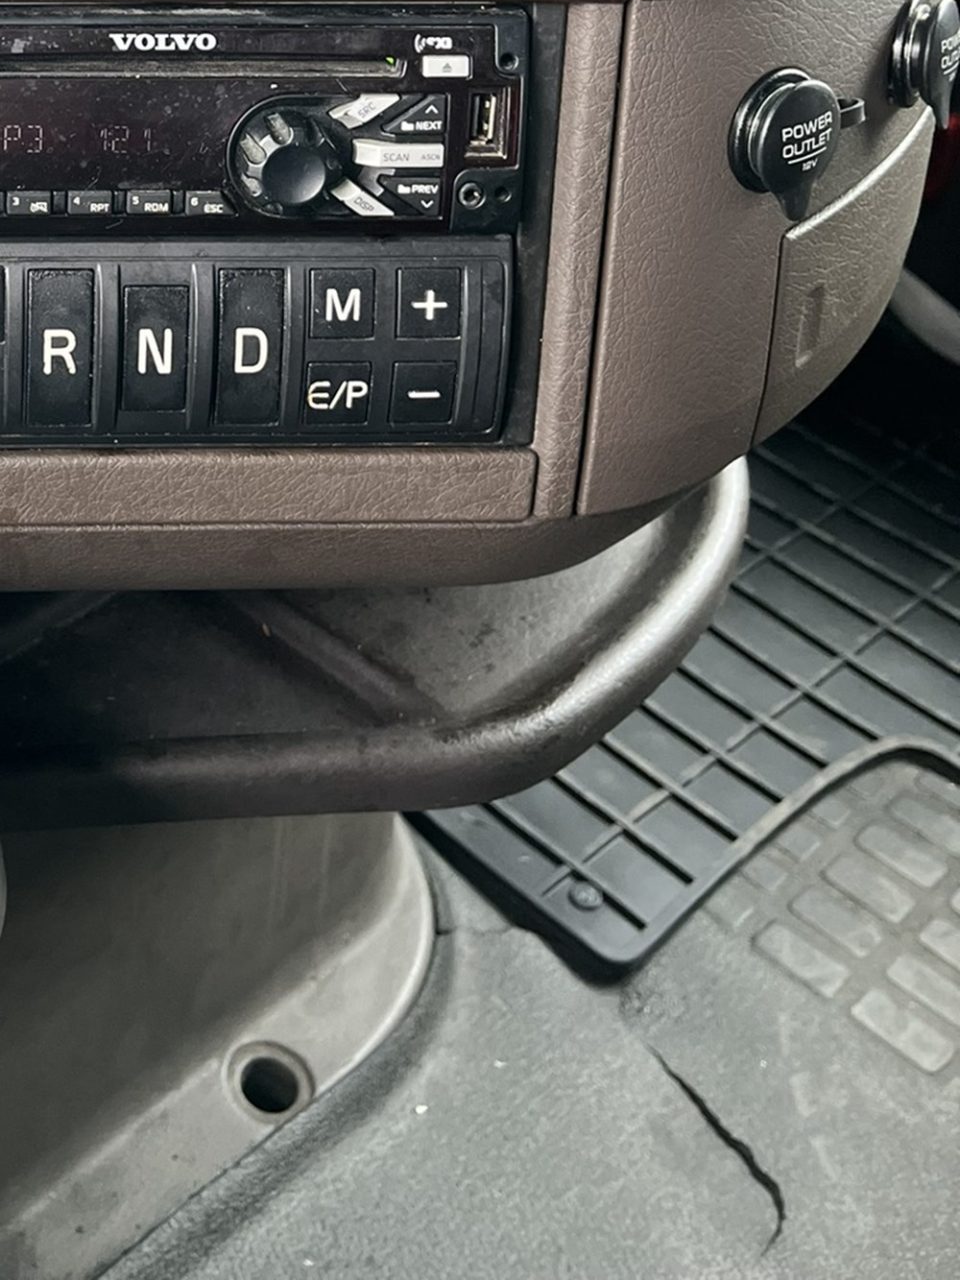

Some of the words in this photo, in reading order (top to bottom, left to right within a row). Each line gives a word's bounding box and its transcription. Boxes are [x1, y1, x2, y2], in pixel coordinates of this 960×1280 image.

[109, 33, 217, 51] VOLVO
[358, 101, 377, 119] SRC
[415, 121, 443, 131] NEXT
[781, 111, 833, 142] POWER
[4, 125, 43, 153] P3
[782, 128, 833, 159] OUTLET
[383, 152, 410, 162] SCAN
[411, 184, 439, 194] PREV
[12, 196, 20, 206] 3
[73, 196, 81, 205] 4
[90, 203, 110, 213] RPT
[132, 196, 139, 205] 5
[191, 197, 199, 207] 6
[204, 204, 224, 214] ESC
[353, 197, 375, 213] DISP
[325, 288, 361, 321] M
[43, 328, 77, 375] R
[138, 327, 173, 375] N
[234, 327, 269, 375] D
[307, 380, 368, 410] E/P
